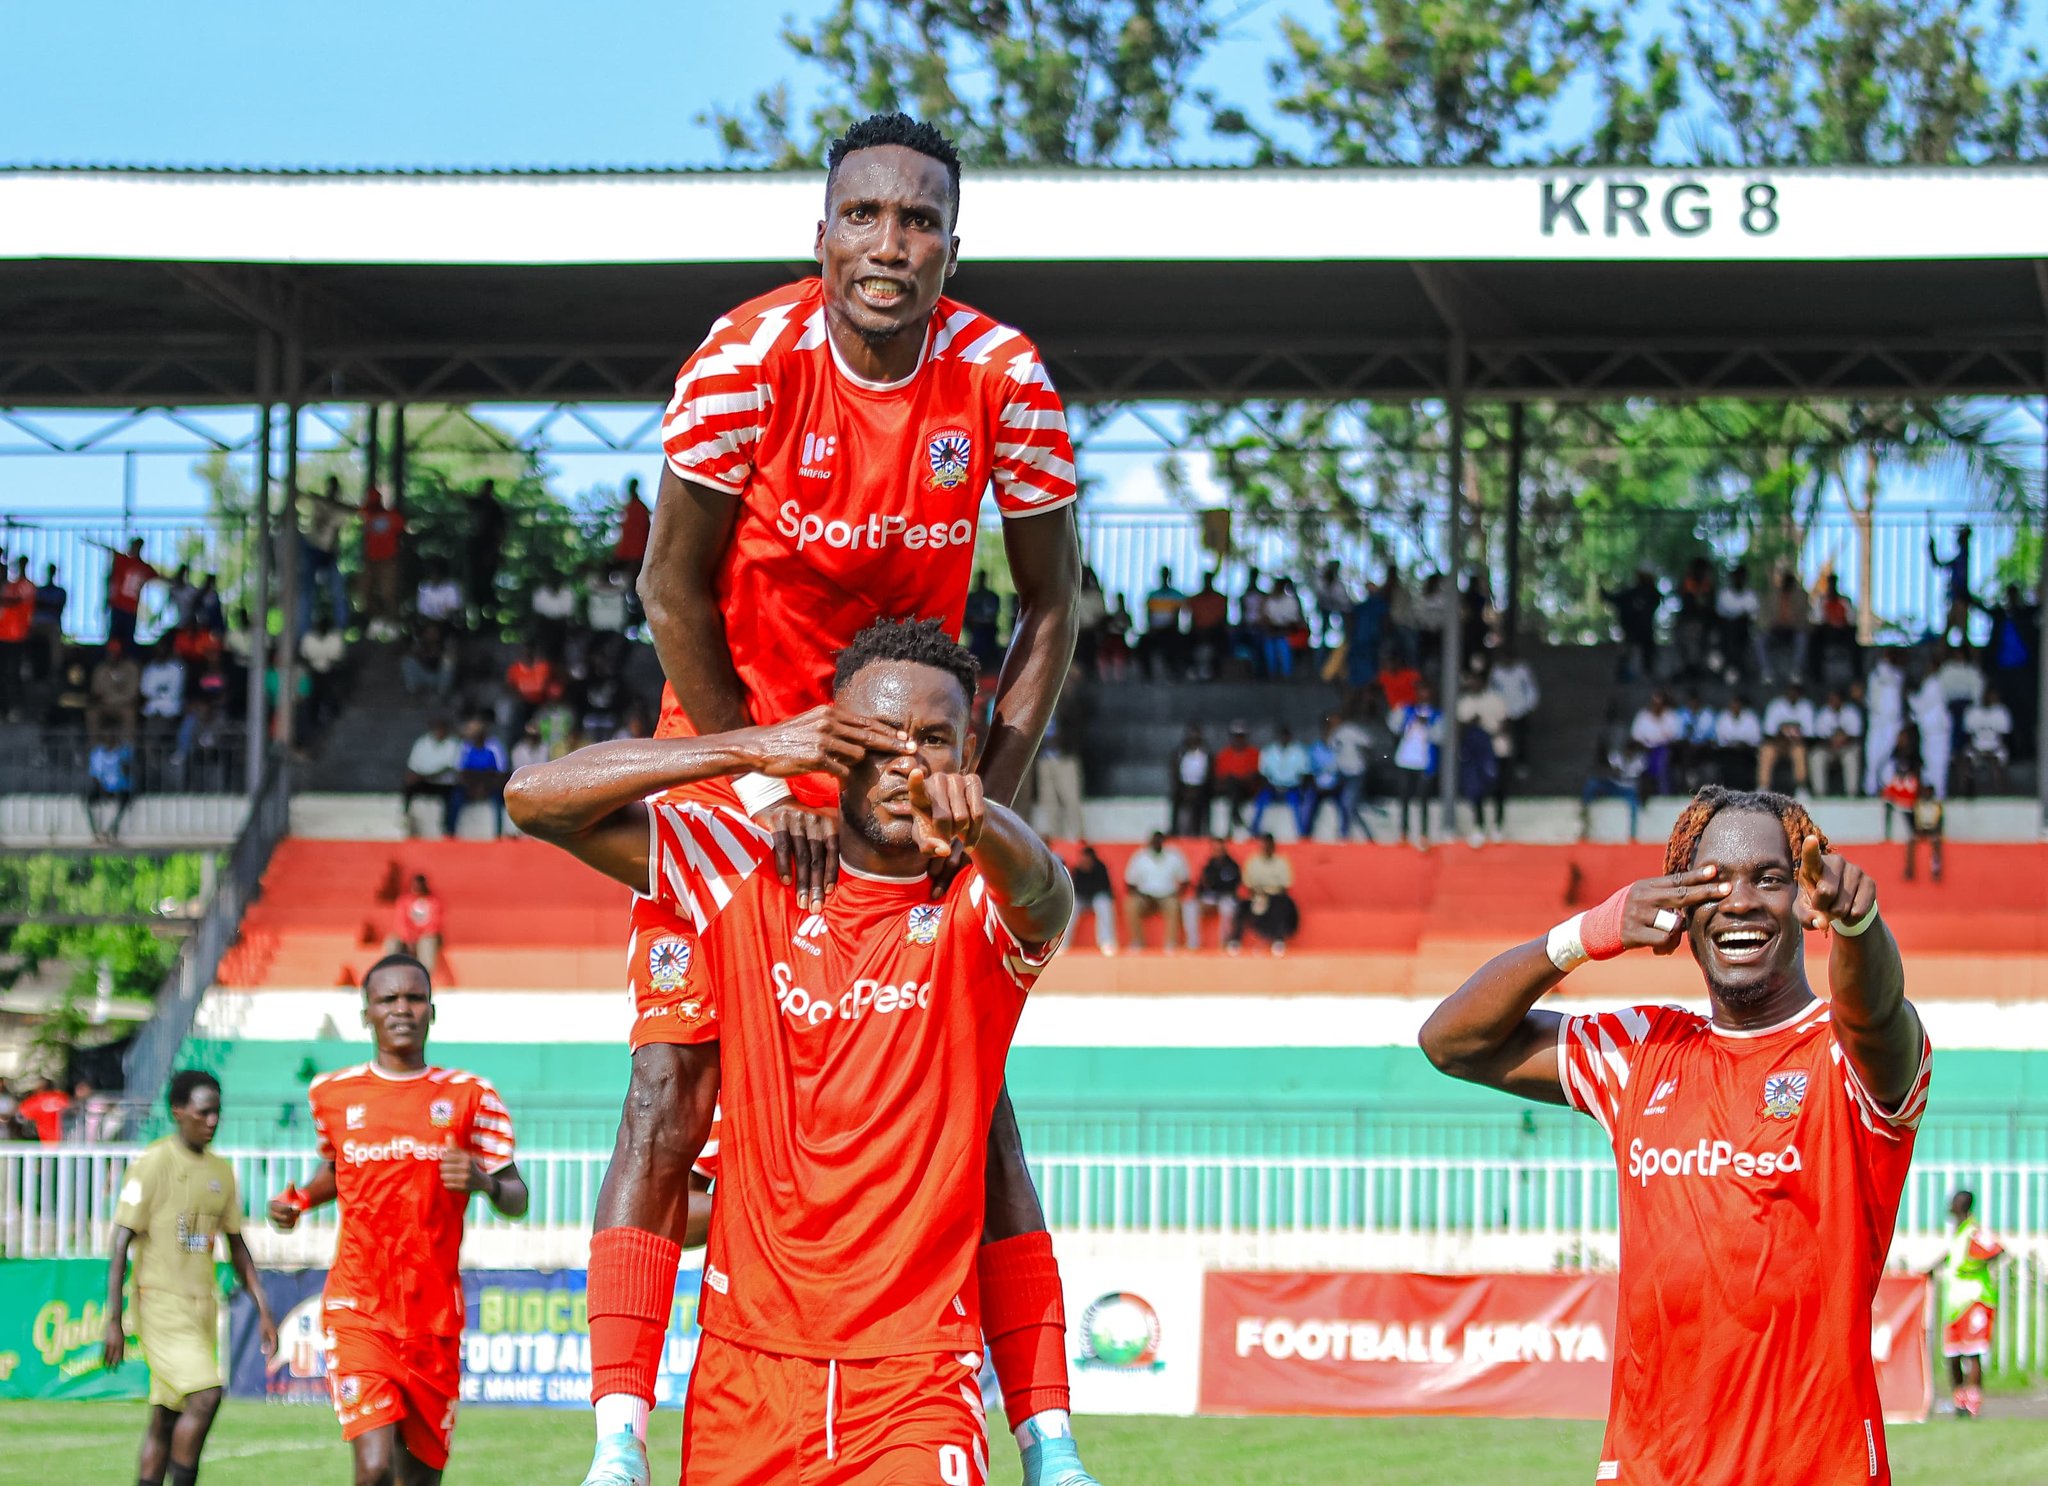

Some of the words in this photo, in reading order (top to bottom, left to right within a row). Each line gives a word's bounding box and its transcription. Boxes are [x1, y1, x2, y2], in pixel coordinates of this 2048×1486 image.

[1540, 182, 1712, 237] KRG
[1741, 183, 1780, 237] 8
[776, 500, 972, 551] SportPesa
[1629, 1137, 1802, 1188] SportPesa
[1235, 1318, 1454, 1364] FOOTBALL
[1462, 1319, 1609, 1363] KENYA
